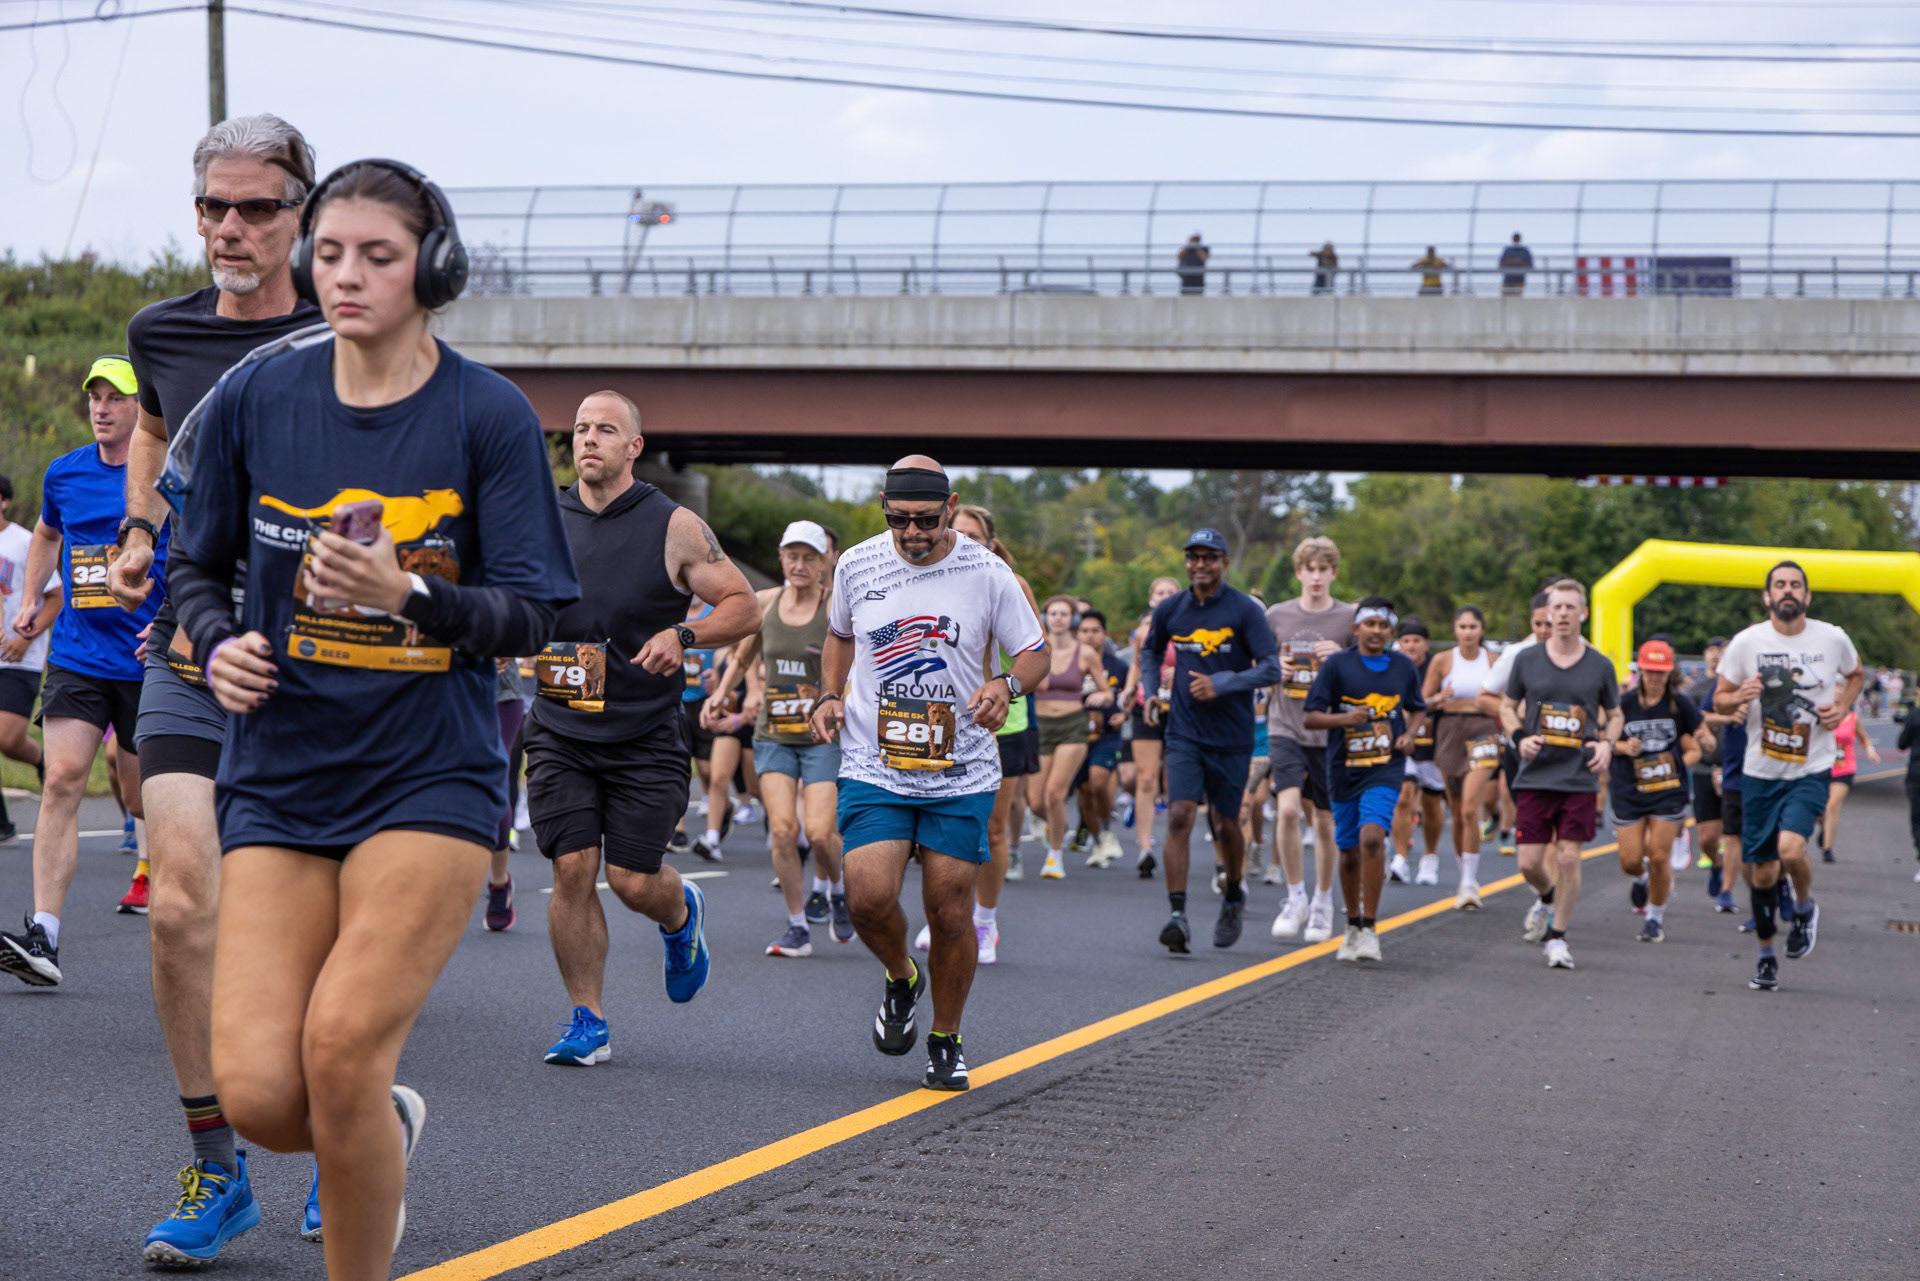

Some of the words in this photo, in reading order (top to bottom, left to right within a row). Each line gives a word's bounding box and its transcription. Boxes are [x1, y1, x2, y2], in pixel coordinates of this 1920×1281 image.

[254, 517, 281, 540] THE
[320, 649, 350, 660] BEER
[411, 657, 442, 667] CHECK
[538, 655, 562, 663] CHASE
[550, 665, 587, 686] 79
[771, 698, 815, 716] 277
[879, 708, 909, 719] CHASE
[911, 712, 925, 720] 5K
[885, 720, 944, 745] 281
[1349, 734, 1391, 752] 274
